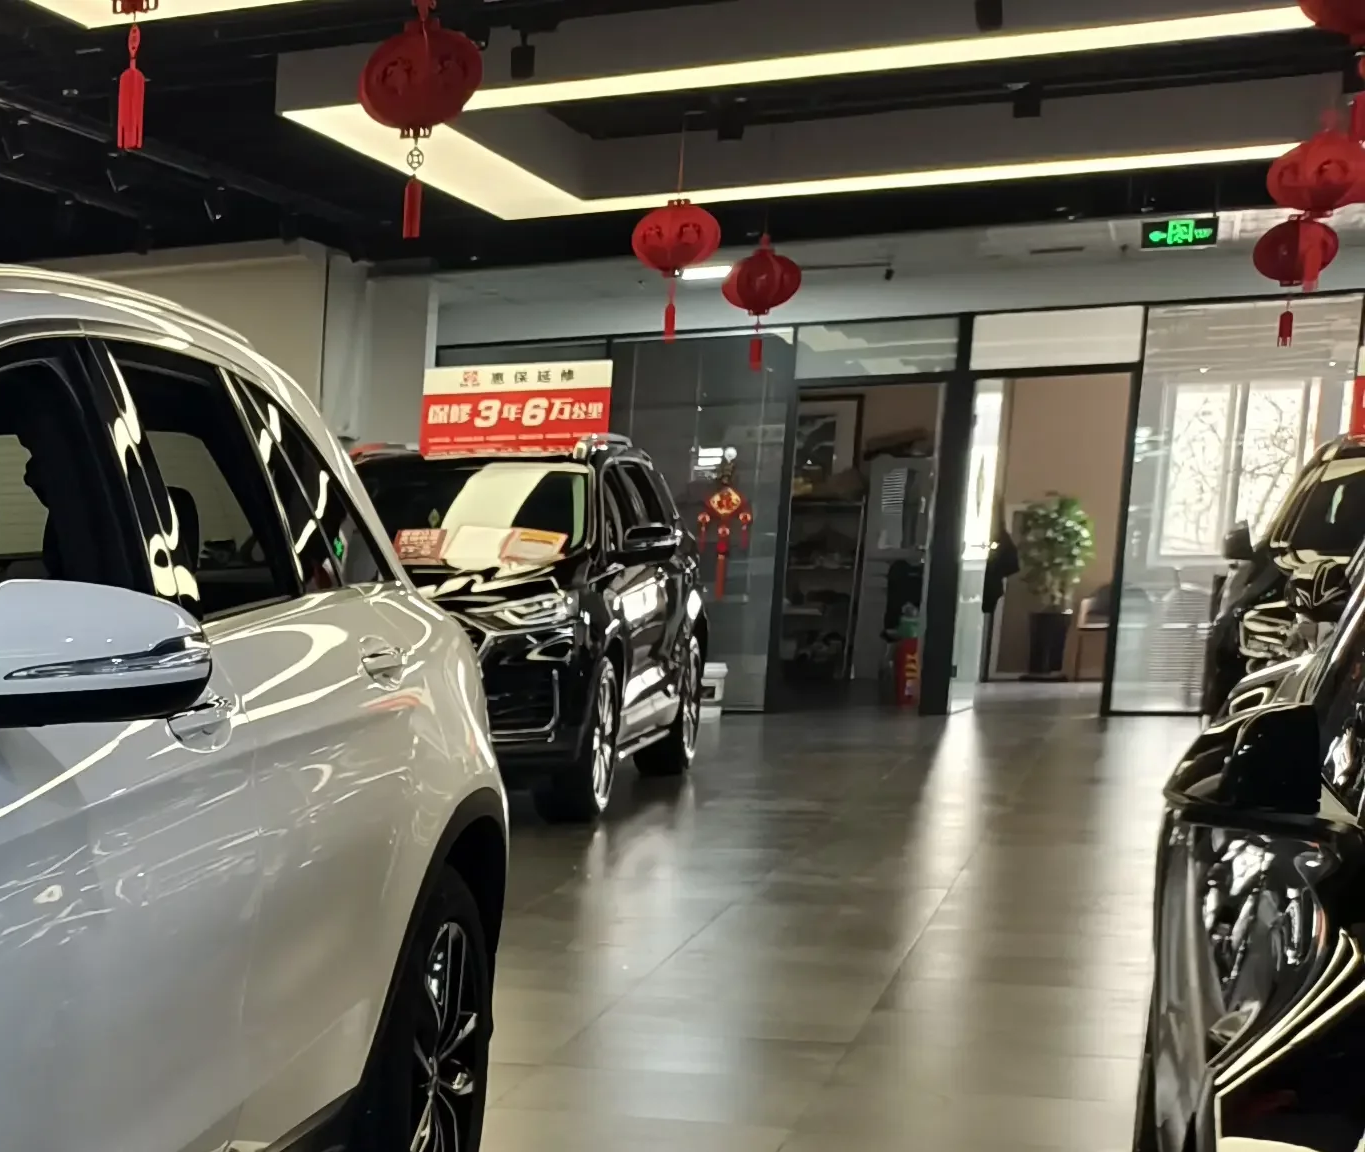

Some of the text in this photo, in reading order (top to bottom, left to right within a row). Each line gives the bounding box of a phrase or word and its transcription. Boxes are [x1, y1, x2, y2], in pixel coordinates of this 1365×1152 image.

[427, 397, 604, 428] 保修3年6万公里
